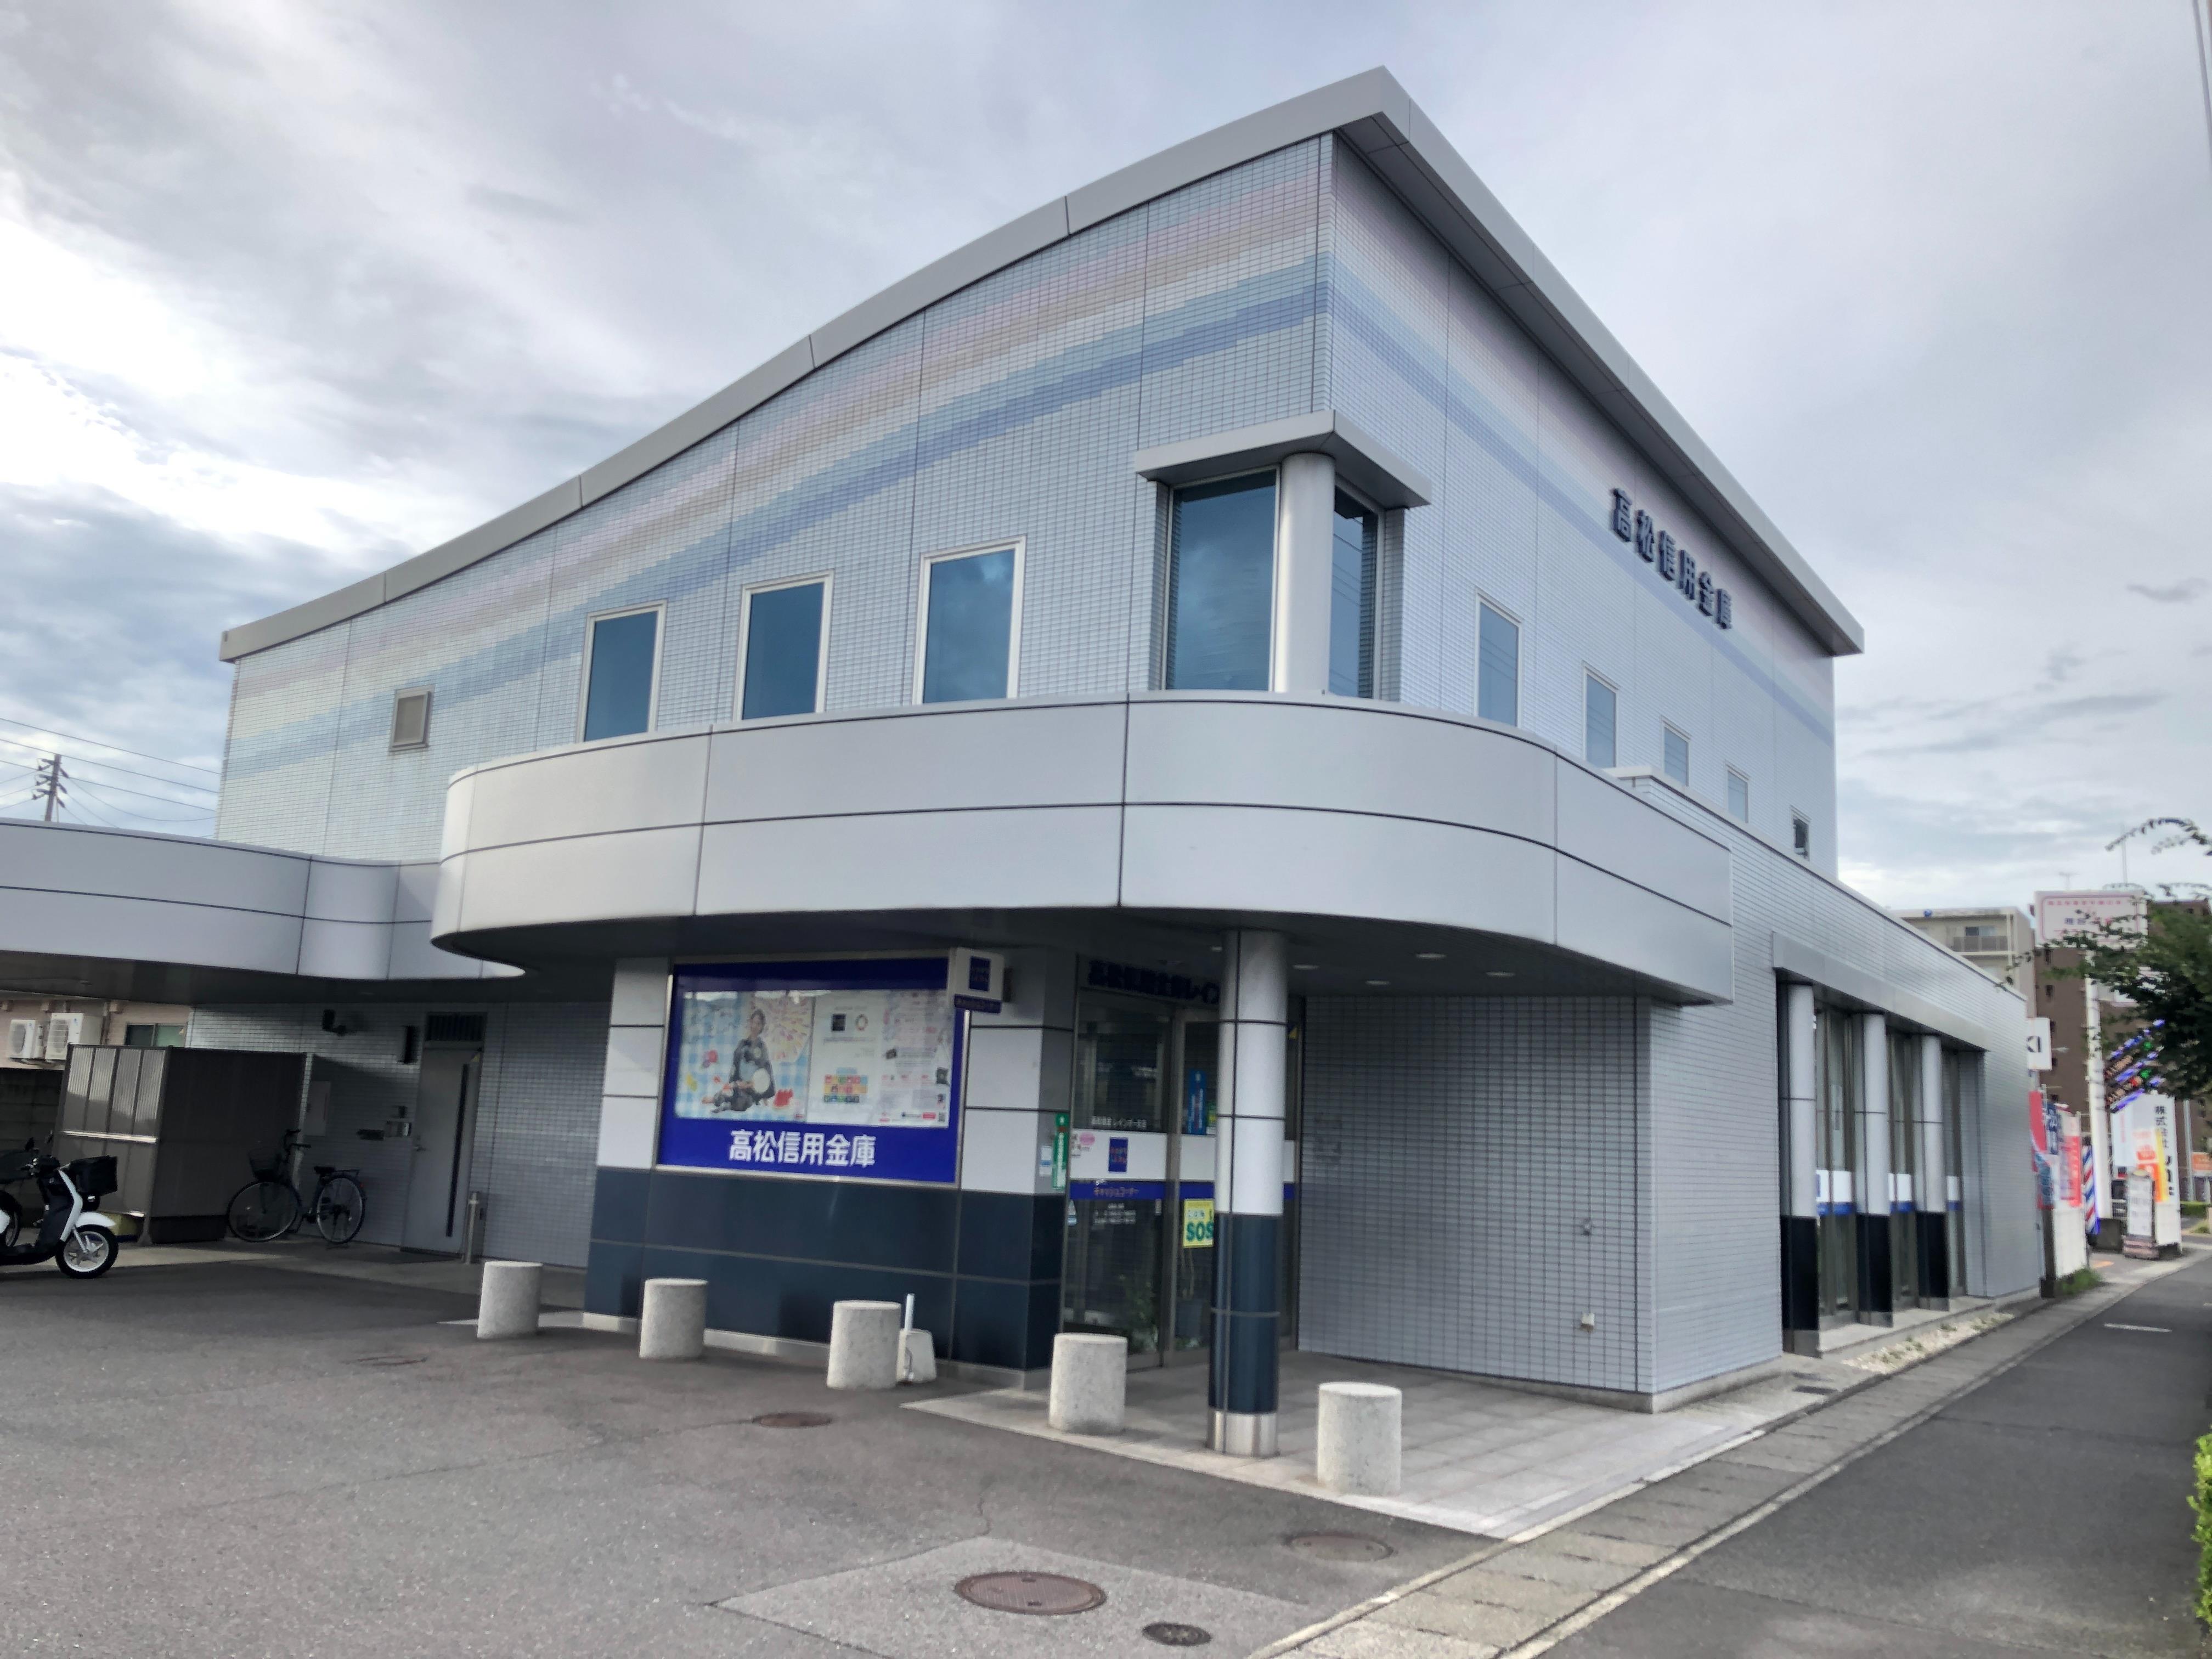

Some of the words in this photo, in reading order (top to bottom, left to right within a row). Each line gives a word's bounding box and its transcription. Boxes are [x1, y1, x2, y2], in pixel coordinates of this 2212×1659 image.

[1610, 488, 1731, 629] 高松信用金庫
[729, 1128, 877, 1168] 高松信用金庫
[1186, 1221, 1214, 1242] SOS
